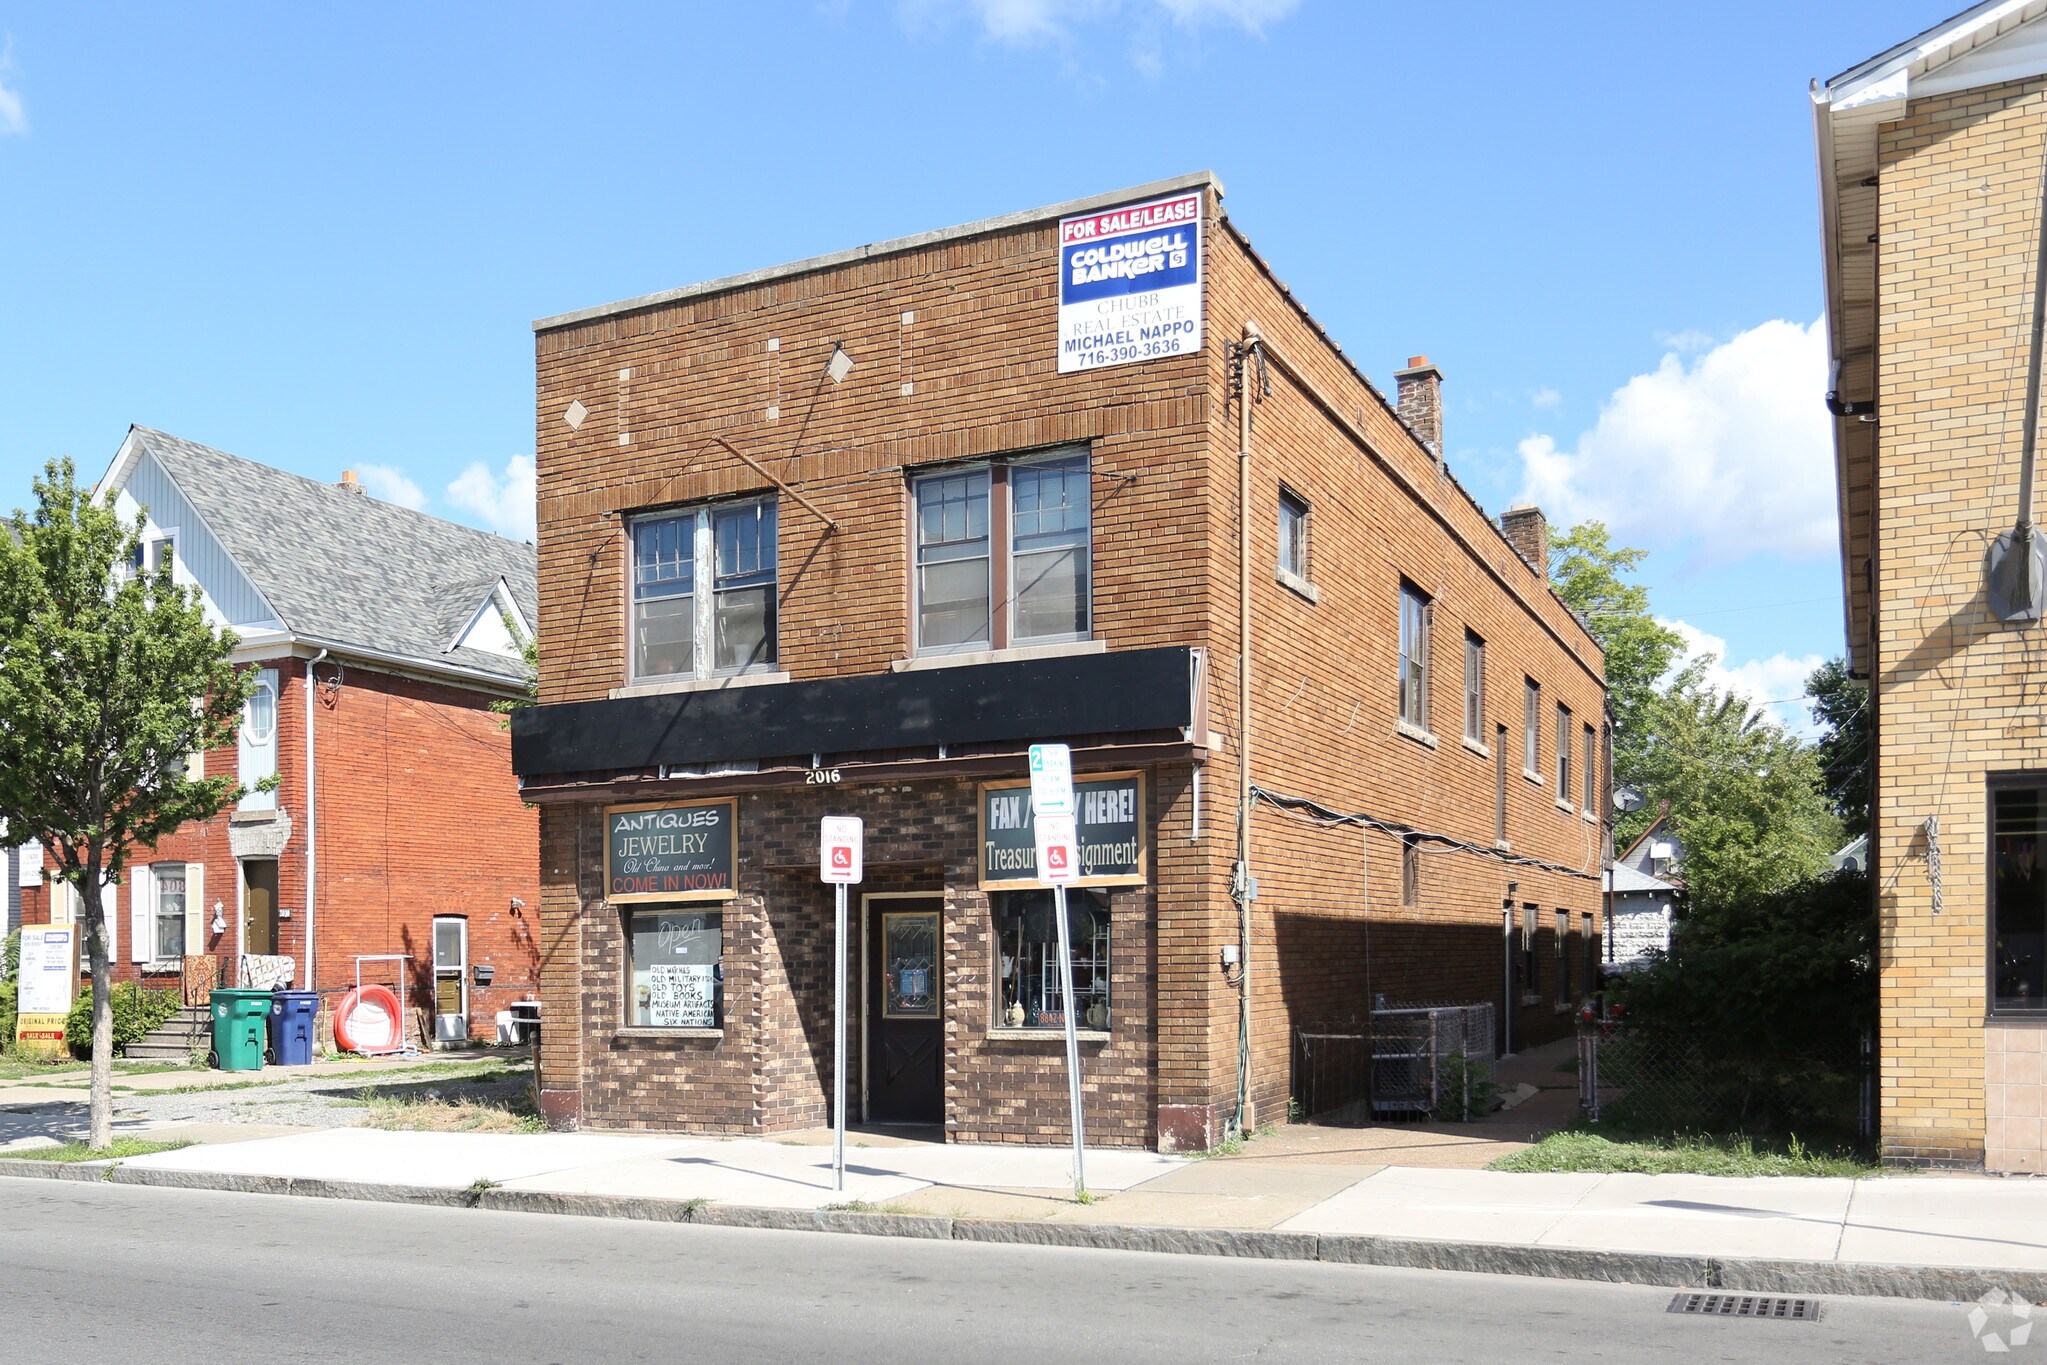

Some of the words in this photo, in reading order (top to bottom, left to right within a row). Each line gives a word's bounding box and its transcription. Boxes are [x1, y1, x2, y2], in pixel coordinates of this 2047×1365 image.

[1064, 220, 1096, 241] FOR
[1100, 201, 1196, 234] SALE/LEASE
[1071, 233, 1188, 268] COLDWELL
[1072, 254, 1165, 286] BANKER
[1097, 292, 1159, 315] CHUBB
[1073, 317, 1116, 336] REAL
[1121, 305, 1185, 328] ESTATE
[1064, 330, 1134, 353] MICHAEL
[1139, 319, 1195, 341] NAPPO
[1078, 338, 1180, 367] 716-390-3636
[805, 768, 841, 786] 2016
[990, 796, 1021, 830] FAX
[1084, 788, 1135, 825] HERE!
[614, 809, 720, 834] ANTIQUES
[836, 824, 847, 833] NO
[1050, 822, 1060, 831] NO
[618, 832, 709, 858] JEWELRY
[824, 834, 859, 845] STANDING
[1039, 833, 1073, 843] STANDING
[985, 840, 1037, 871] Treasur
[623, 857, 642, 874] Old
[643, 856, 670, 873] China
[673, 860, 692, 872] and
[691, 857, 716, 871] more!
[612, 875, 659, 894] COME
[663, 874, 682, 891] IN
[683, 872, 728, 890] NOW!
[657, 918, 702, 955] Open
[651, 966, 665, 974] OLD
[651, 975, 666, 983] OLD
[668, 974, 701, 983] MILITARY
[651, 983, 668, 991] OLD
[671, 982, 695, 992] TOYS
[651, 991, 667, 1000] OLD
[673, 991, 703, 1001] BOOKS
[651, 1000, 681, 1009] MUSEUM
[655, 1009, 680, 1017] NATIVE
[19, 1017, 45, 1025] ORIGINAL
[47, 1017, 66, 1025] PRICE
[663, 1018, 678, 1026] SIX
[680, 1018, 713, 1026] NATIONS
